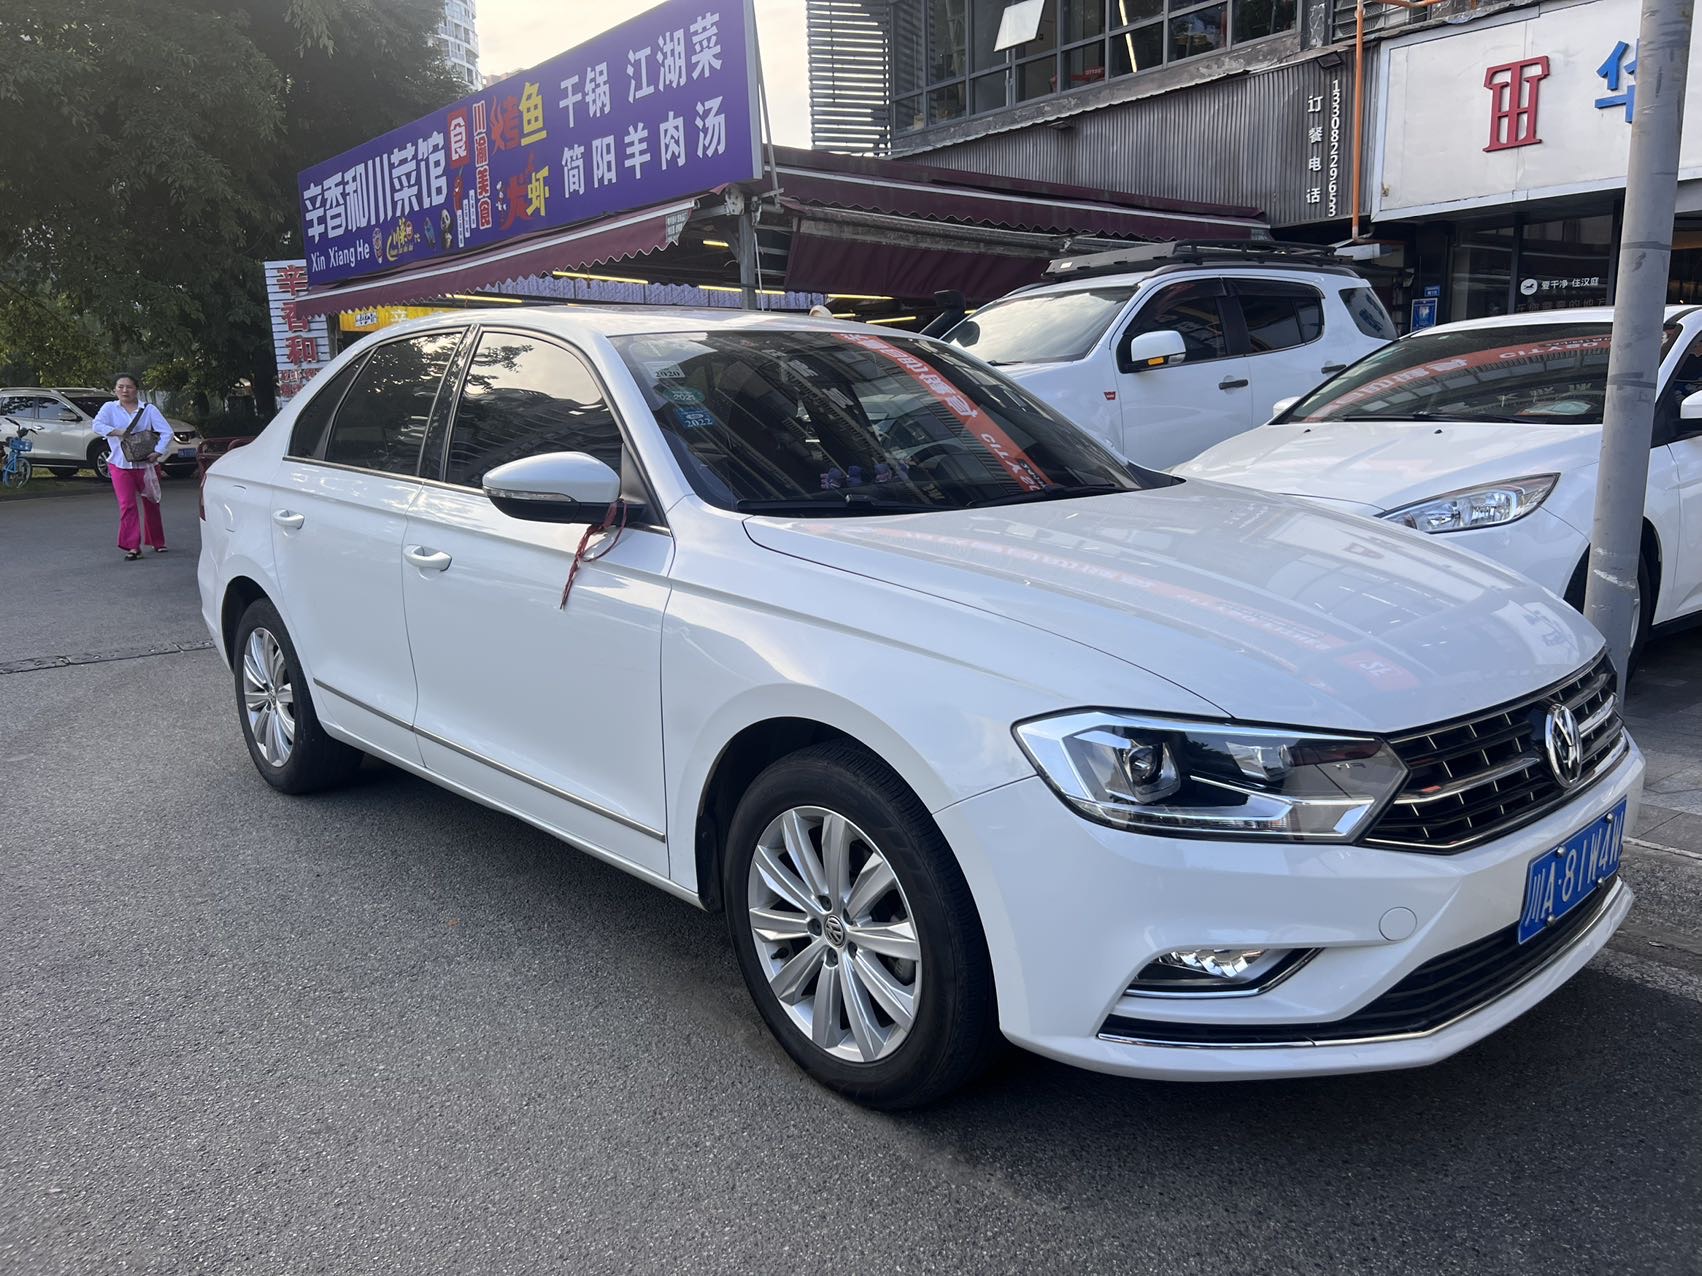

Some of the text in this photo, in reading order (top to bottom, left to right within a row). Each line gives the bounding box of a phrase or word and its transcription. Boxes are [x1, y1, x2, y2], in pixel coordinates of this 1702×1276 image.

[559, 12, 723, 128] 干锅 江湖菜
[303, 130, 448, 244] 辛香和川菜馆
[472, 100, 493, 230] 川渝美食
[561, 96, 726, 198] 简阳羊肉汤
[1306, 95, 1323, 204] 订餐电话
[1328, 79, 1341, 217] 13308229653
[311, 252, 326, 273] Xin
[328, 246, 356, 268] Xiang
[356, 239, 370, 261] He
[655, 370, 681, 378] 2020
[685, 418, 714, 428] 2022
